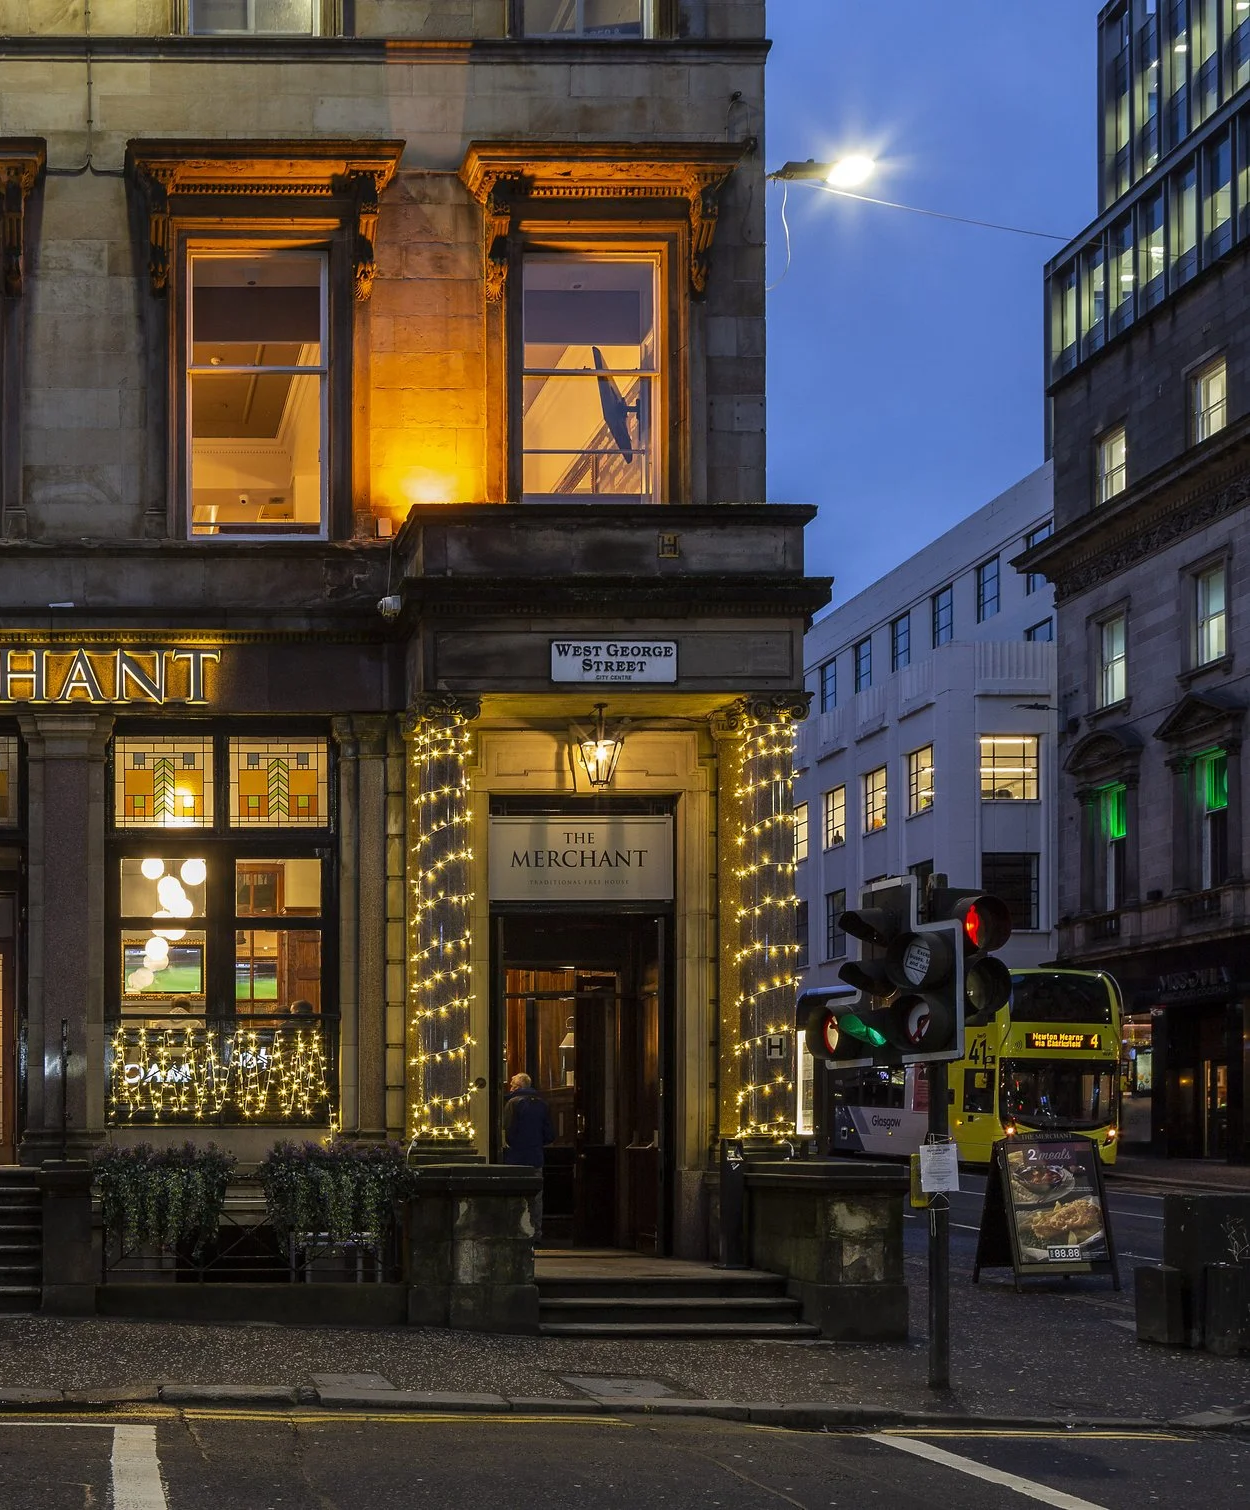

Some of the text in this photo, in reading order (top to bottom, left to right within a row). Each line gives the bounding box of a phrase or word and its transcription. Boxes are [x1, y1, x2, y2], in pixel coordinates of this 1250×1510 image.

[563, 832, 595, 845] THE
[510, 850, 649, 868] MERCHANT
[1032, 1033, 1058, 1041] Newton
[1090, 1033, 1099, 1049] 4
[969, 1039, 987, 1065] 41
[871, 1114, 902, 1130] Glasgow
[1021, 1132, 1072, 1141] THE MERCHANT
[1027, 1147, 1072, 1161] 2 meals
